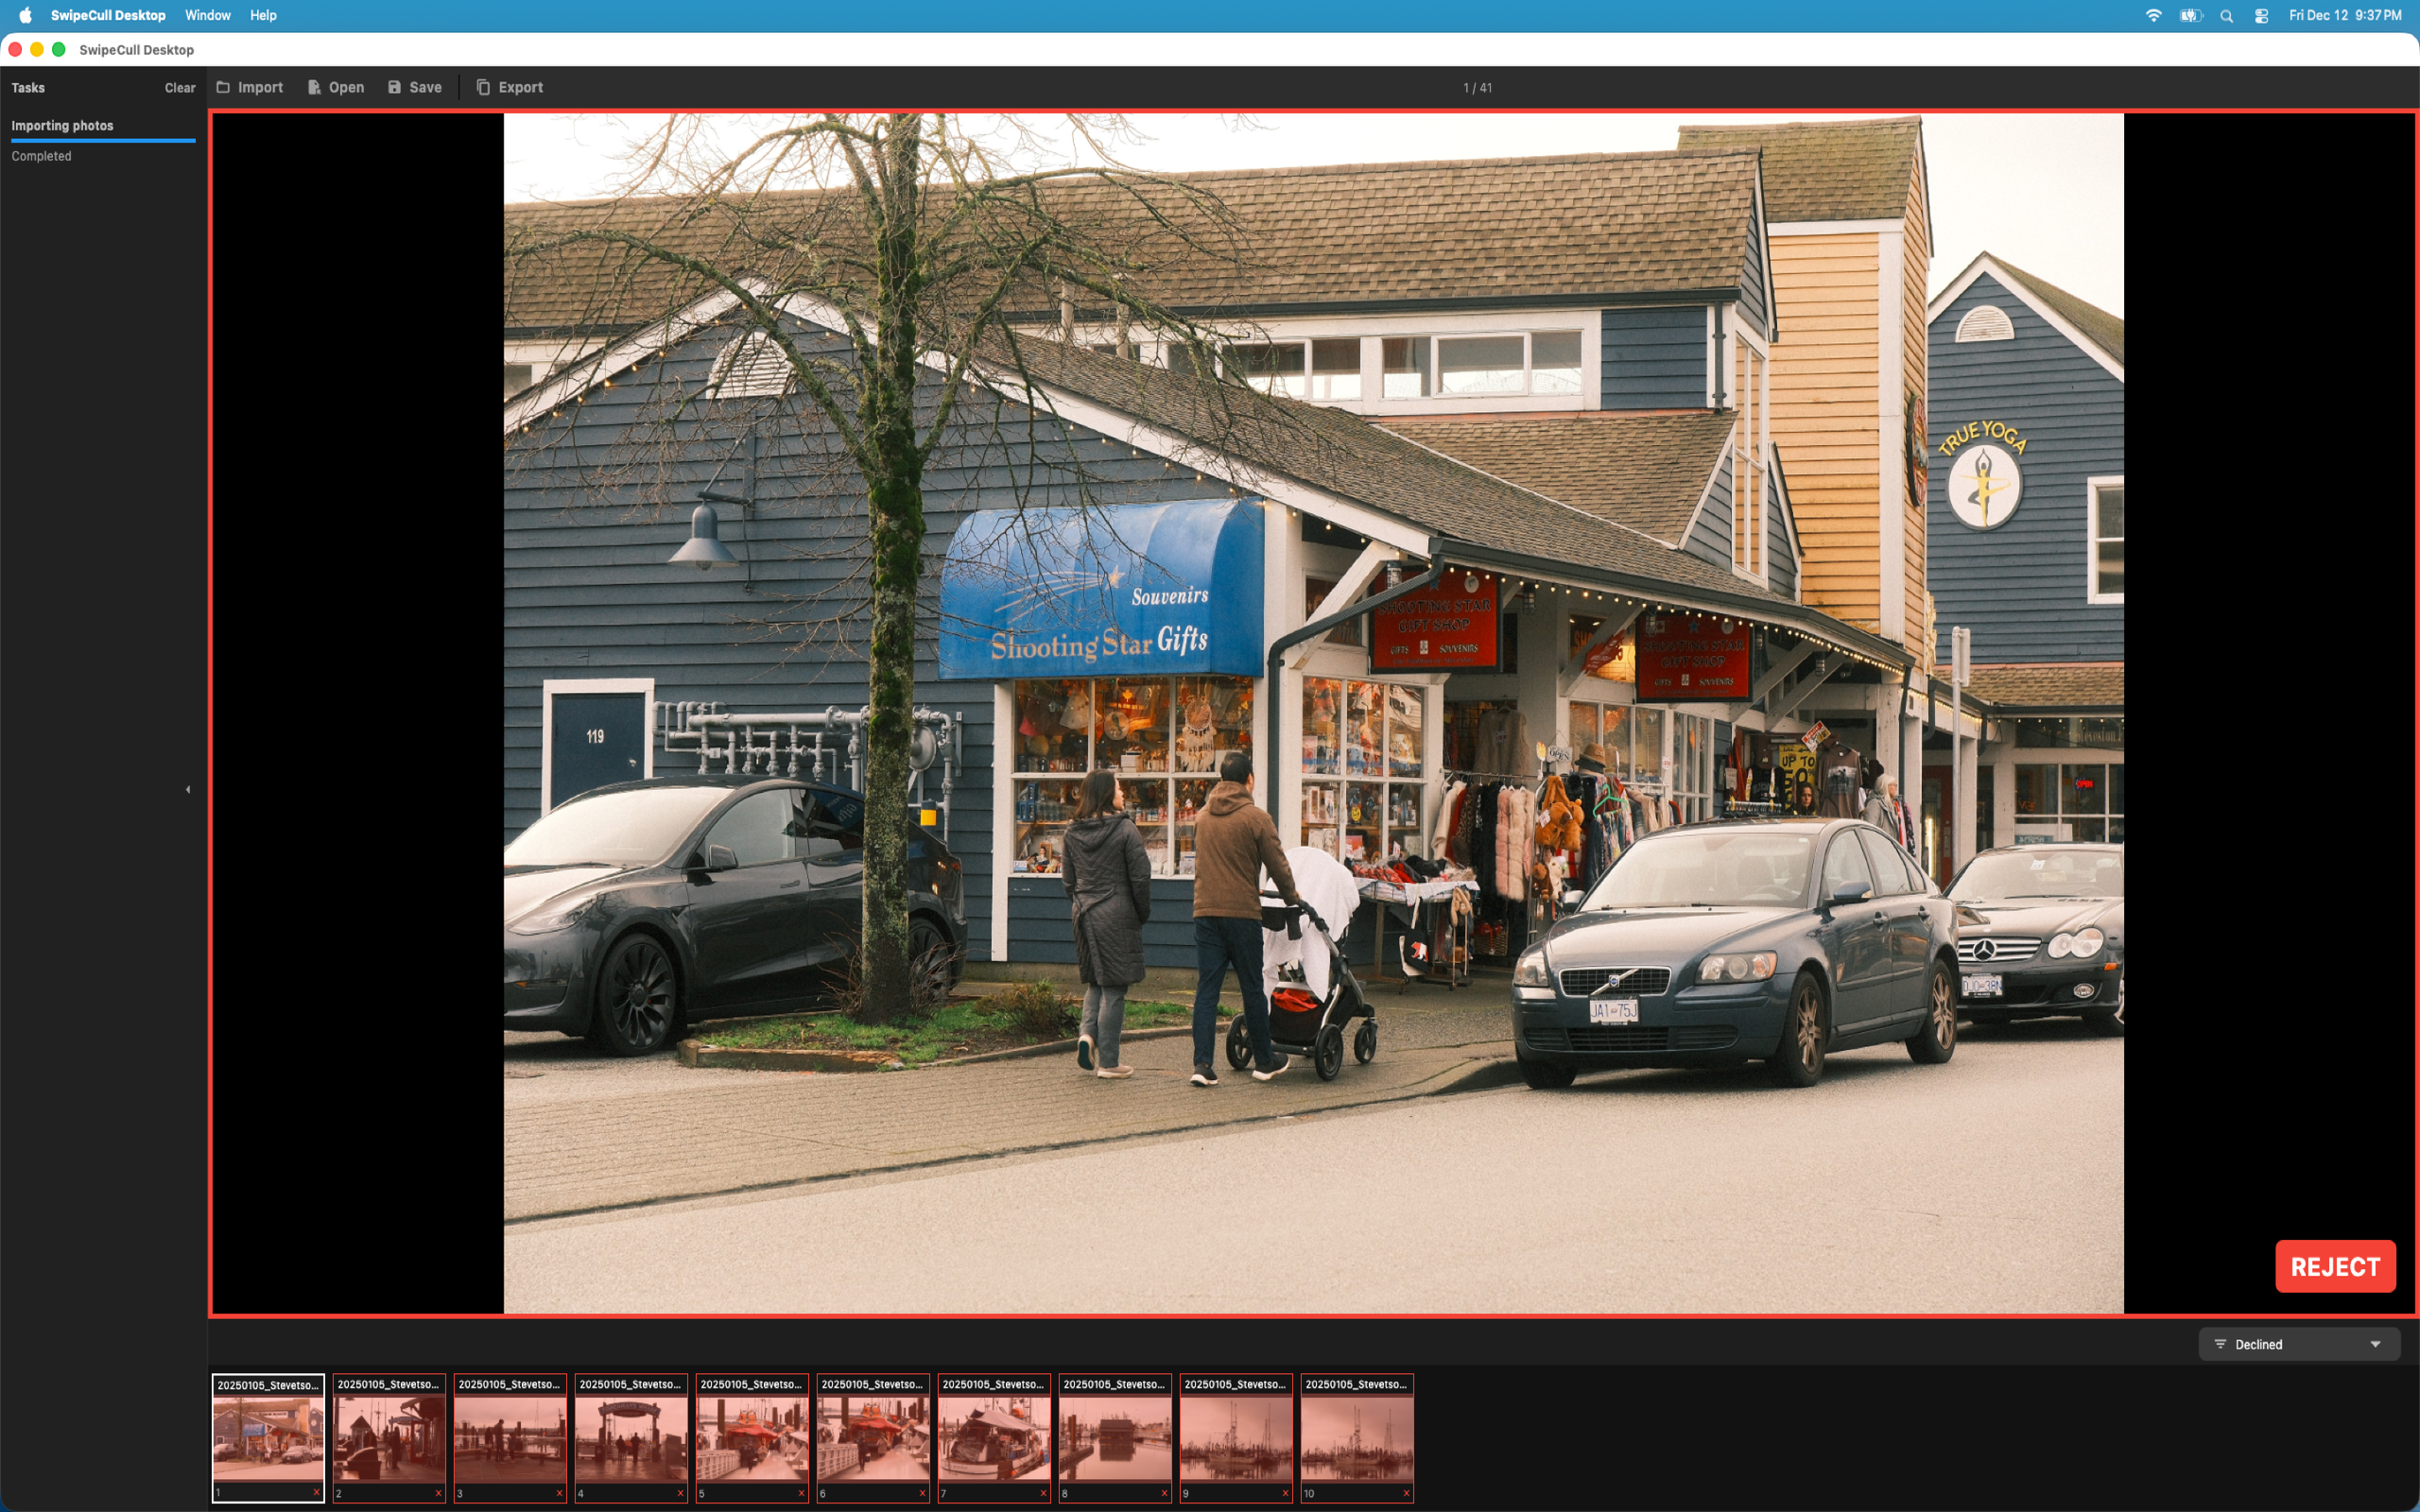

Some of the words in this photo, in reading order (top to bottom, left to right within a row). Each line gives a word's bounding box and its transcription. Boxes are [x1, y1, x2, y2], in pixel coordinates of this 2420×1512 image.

[51, 9, 112, 23] SwipeCull
[115, 9, 165, 23] Desktop
[185, 9, 231, 21] Window
[251, 9, 277, 23] Help
[2290, 9, 2304, 20] Fri
[2308, 9, 2330, 21] Dec
[2335, 9, 2348, 21] 12
[2356, 9, 2381, 21] 9:37
[2384, 9, 2401, 20] PM
[80, 44, 140, 58] SwipeCull
[144, 44, 194, 58] Desktop
[11, 82, 44, 93] Tasks
[165, 82, 196, 93] Clear
[239, 82, 283, 95] Import
[330, 81, 364, 95] Open
[410, 81, 441, 93] Save
[500, 82, 543, 95] Export
[1464, 83, 1468, 93] 1
[1473, 83, 1476, 94] /
[1480, 83, 1491, 93] 41
[12, 120, 69, 133] Importing
[75, 120, 113, 132] photos
[12, 151, 71, 163] Completed
[1938, 421, 1980, 456] TRUE
[1981, 420, 2029, 456] YOGA
[1132, 585, 1209, 607] Souvenirs
[1378, 600, 1452, 615] SHOOTING
[1454, 598, 1491, 613] STAR
[1399, 619, 1429, 633] GIFT
[1432, 618, 1470, 632] SHOP
[991, 628, 1098, 664] Shooting
[1102, 627, 1153, 656] Star
[1157, 625, 1208, 657] Gifts
[1390, 645, 1409, 655] GIFTS
[1439, 644, 1478, 654] SOUVENIRS
[1644, 641, 1709, 652] SHOOTING
[1711, 640, 1745, 651] STAR
[1661, 656, 1689, 668] GIFT
[1691, 656, 1725, 668] SHOP
[1699, 678, 1734, 686] SOUVENIRS
[587, 729, 605, 745] 119
[1782, 756, 1796, 767] UP
[1800, 755, 1815, 766] TO
[2076, 780, 2094, 789] OPEN
[2292, 1257, 2380, 1277] REJECT
[2237, 1339, 2282, 1349] Declined
[218, 1381, 319, 1391] 20250105_Stevetso...
[338, 1380, 439, 1390] 20250105_Stevetso...
[459, 1380, 560, 1390] 20250105_Stevetso...
[580, 1380, 681, 1390] 20250105_Stevetso...
[701, 1380, 802, 1390] 20250105_Stevetso...
[822, 1380, 923, 1390] 20250105_Stevetso...
[943, 1380, 1044, 1390] 20250105_Stevetso...
[1064, 1380, 1165, 1390] 20250105_Stevetso...
[1185, 1380, 1286, 1390] 20250105_Stevetso...
[1306, 1380, 1407, 1390] 20250105_Stevetso...
[337, 1489, 341, 1498] 2
[458, 1489, 462, 1498] 3
[579, 1489, 583, 1498] 4
[821, 1489, 825, 1498] 6
[1063, 1489, 1067, 1498] 8
[1184, 1489, 1188, 1498] 9
[1305, 1489, 1314, 1498] 10
